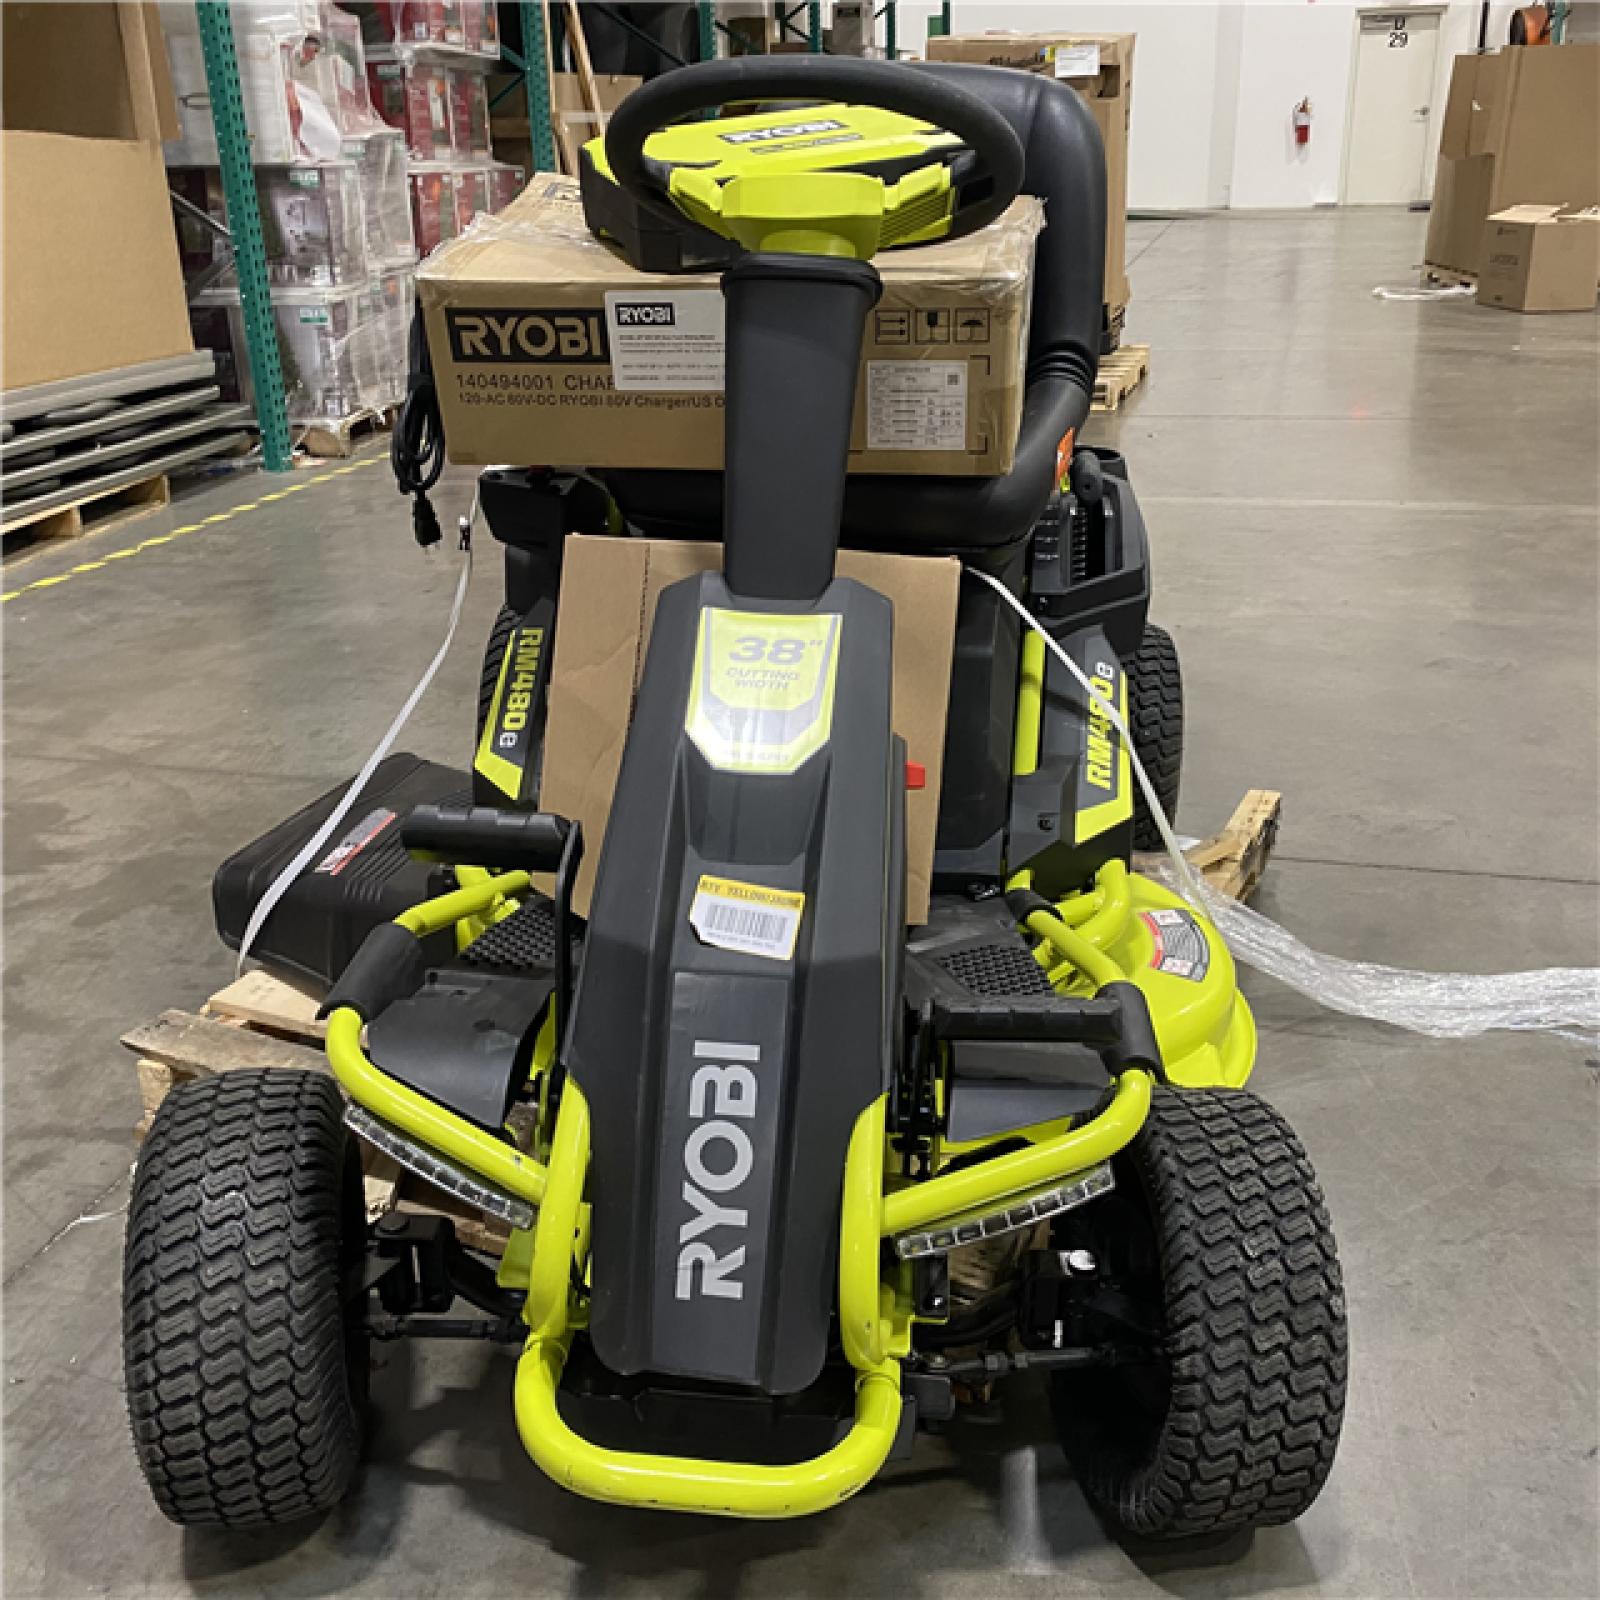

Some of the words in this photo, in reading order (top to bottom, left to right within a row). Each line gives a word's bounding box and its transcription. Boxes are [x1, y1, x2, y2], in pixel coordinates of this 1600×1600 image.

[1389, 32, 1408, 48] 29
[619, 306, 671, 323] RYOBI
[454, 315, 602, 356] RYOBI
[560, 394, 603, 407] RYOBI
[726, 667, 800, 681] CUTTING
[735, 678, 790, 690] WIDTH
[675, 1039, 760, 1300] RYOBI
